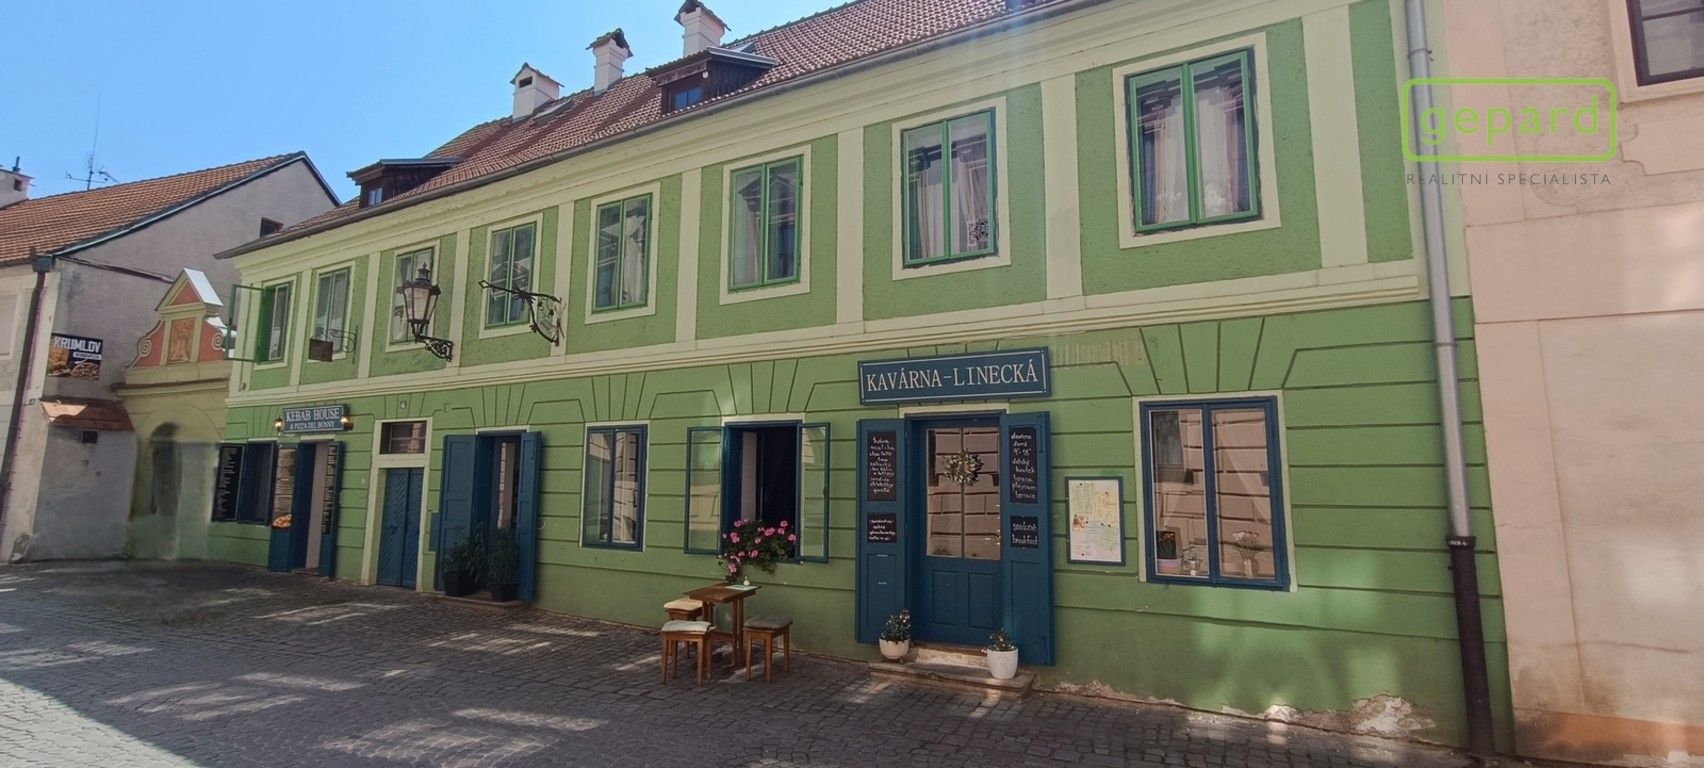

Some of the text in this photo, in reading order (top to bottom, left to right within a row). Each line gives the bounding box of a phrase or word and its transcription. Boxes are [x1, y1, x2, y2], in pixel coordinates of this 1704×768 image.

[54, 336, 101, 352] KRUMLOV
[286, 407, 340, 422] KEBAB HOUSE
